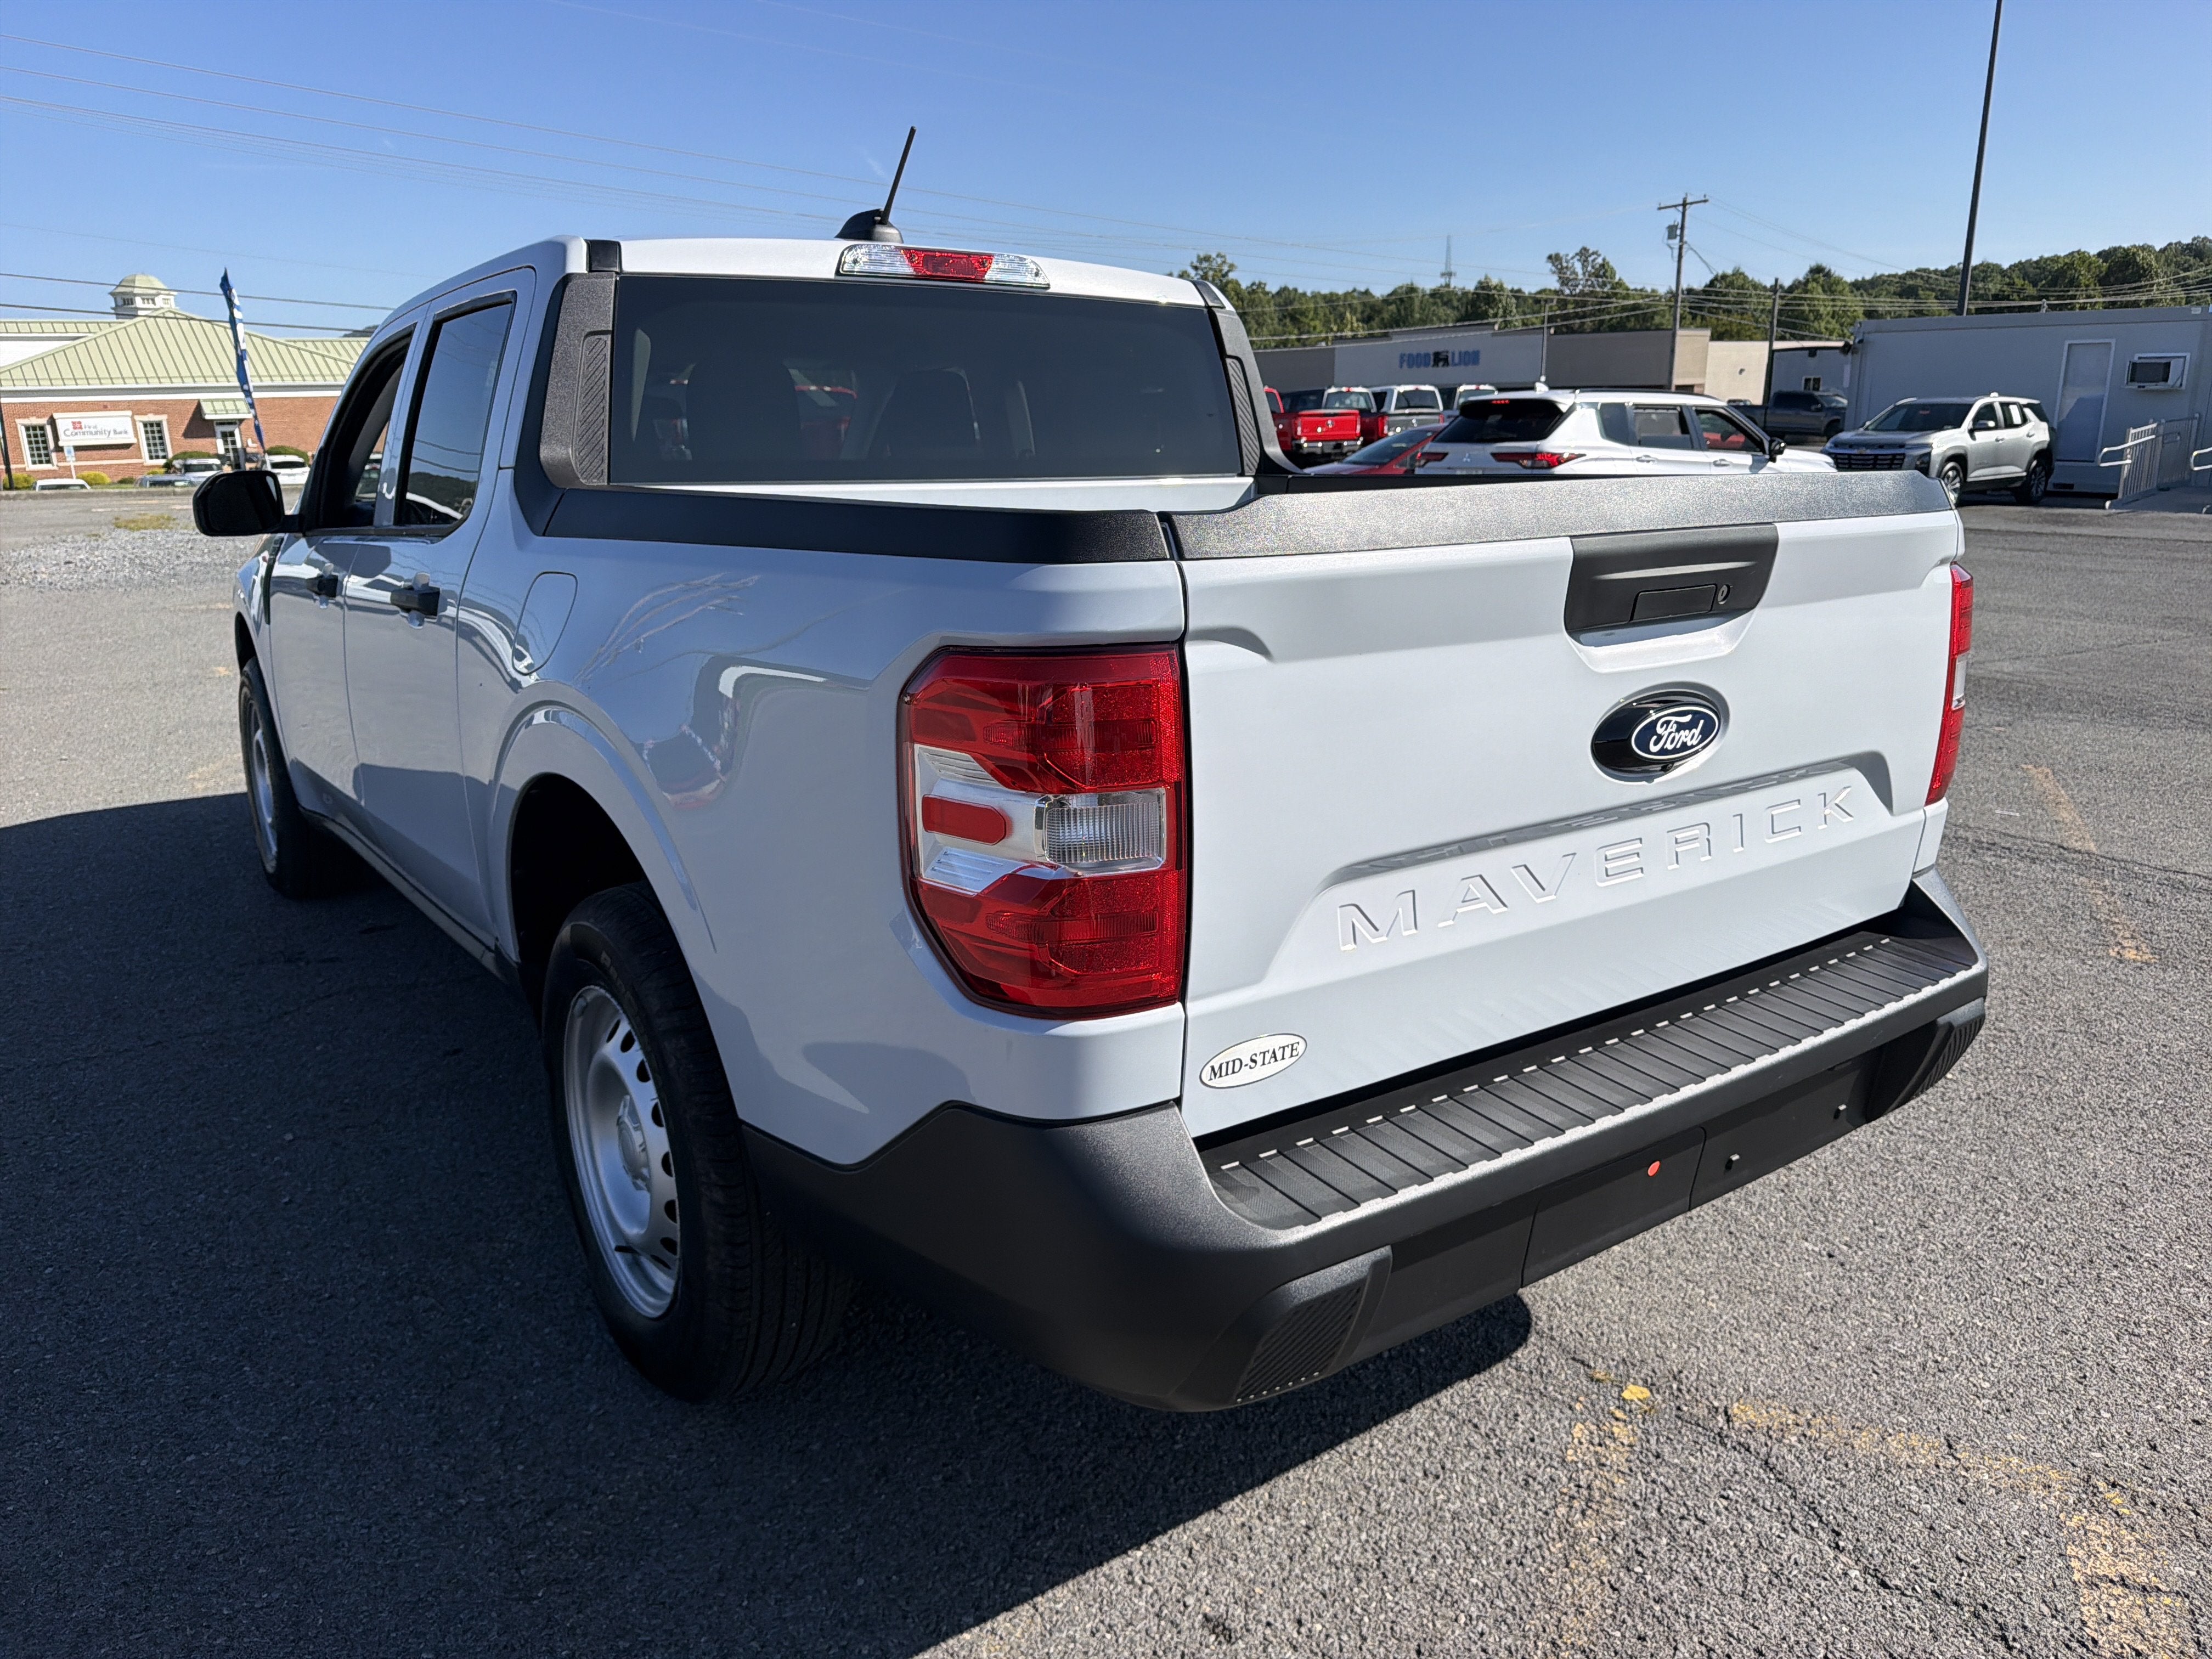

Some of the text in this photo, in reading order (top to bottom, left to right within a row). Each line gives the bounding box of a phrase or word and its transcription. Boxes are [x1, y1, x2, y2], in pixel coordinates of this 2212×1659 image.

[1398, 349, 1480, 369] FOOD LION
[63, 428, 111, 437] Community
[1649, 714, 1705, 753] Ford
[1337, 786, 1854, 951] MAVERICK
[1207, 1041, 1300, 1081] MID-STATE
